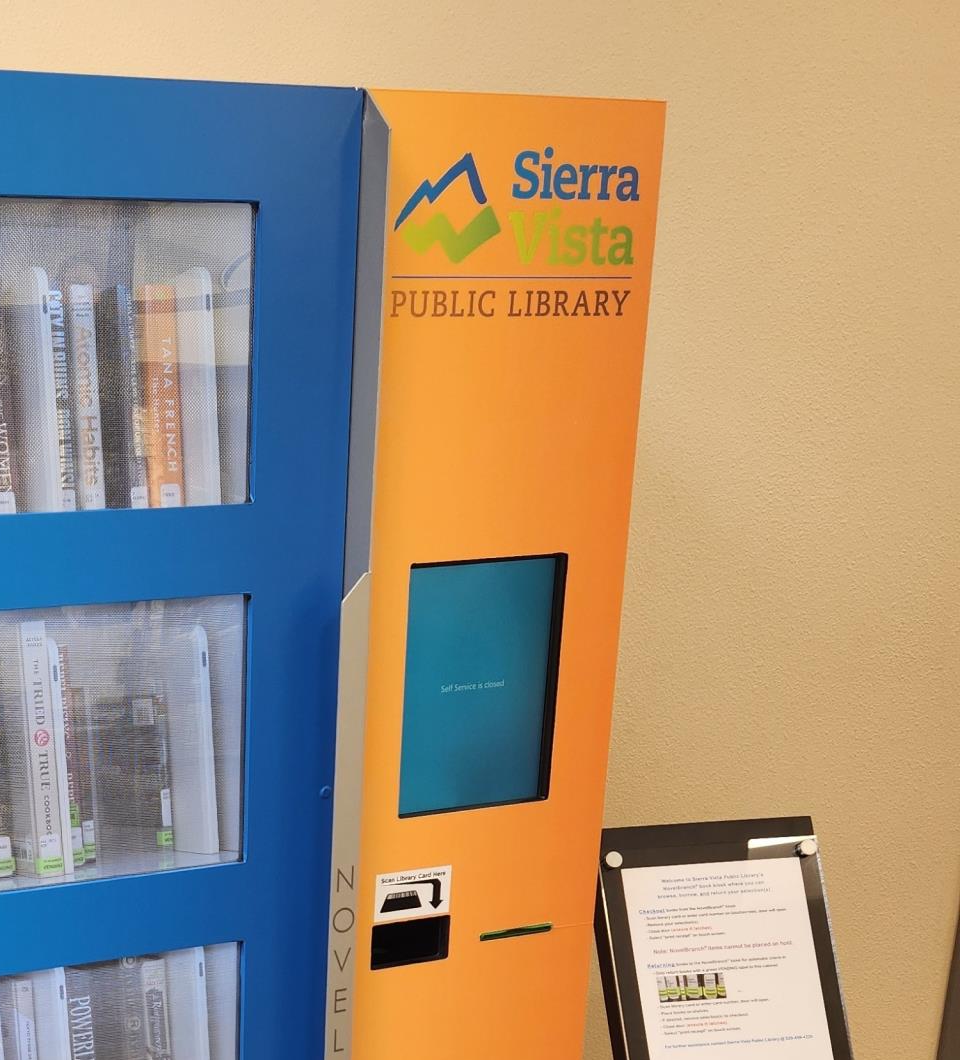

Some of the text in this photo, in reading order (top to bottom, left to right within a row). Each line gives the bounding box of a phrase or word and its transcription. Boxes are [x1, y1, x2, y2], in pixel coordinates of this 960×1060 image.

[512, 147, 639, 201] Sierra
[508, 208, 634, 265] Vista
[391, 290, 631, 317] PUBLIC LIBRARY
[74, 326, 101, 487] Atomic Habits
[152, 402, 160, 434] Hunter
[158, 337, 178, 473] TANA FRENCH
[33, 680, 45, 727] TRIED
[440, 684, 453, 693] Self
[454, 683, 477, 692] Service
[483, 679, 505, 689] closed
[38, 751, 51, 791] TRUE
[396, 874, 416, 882] Library
